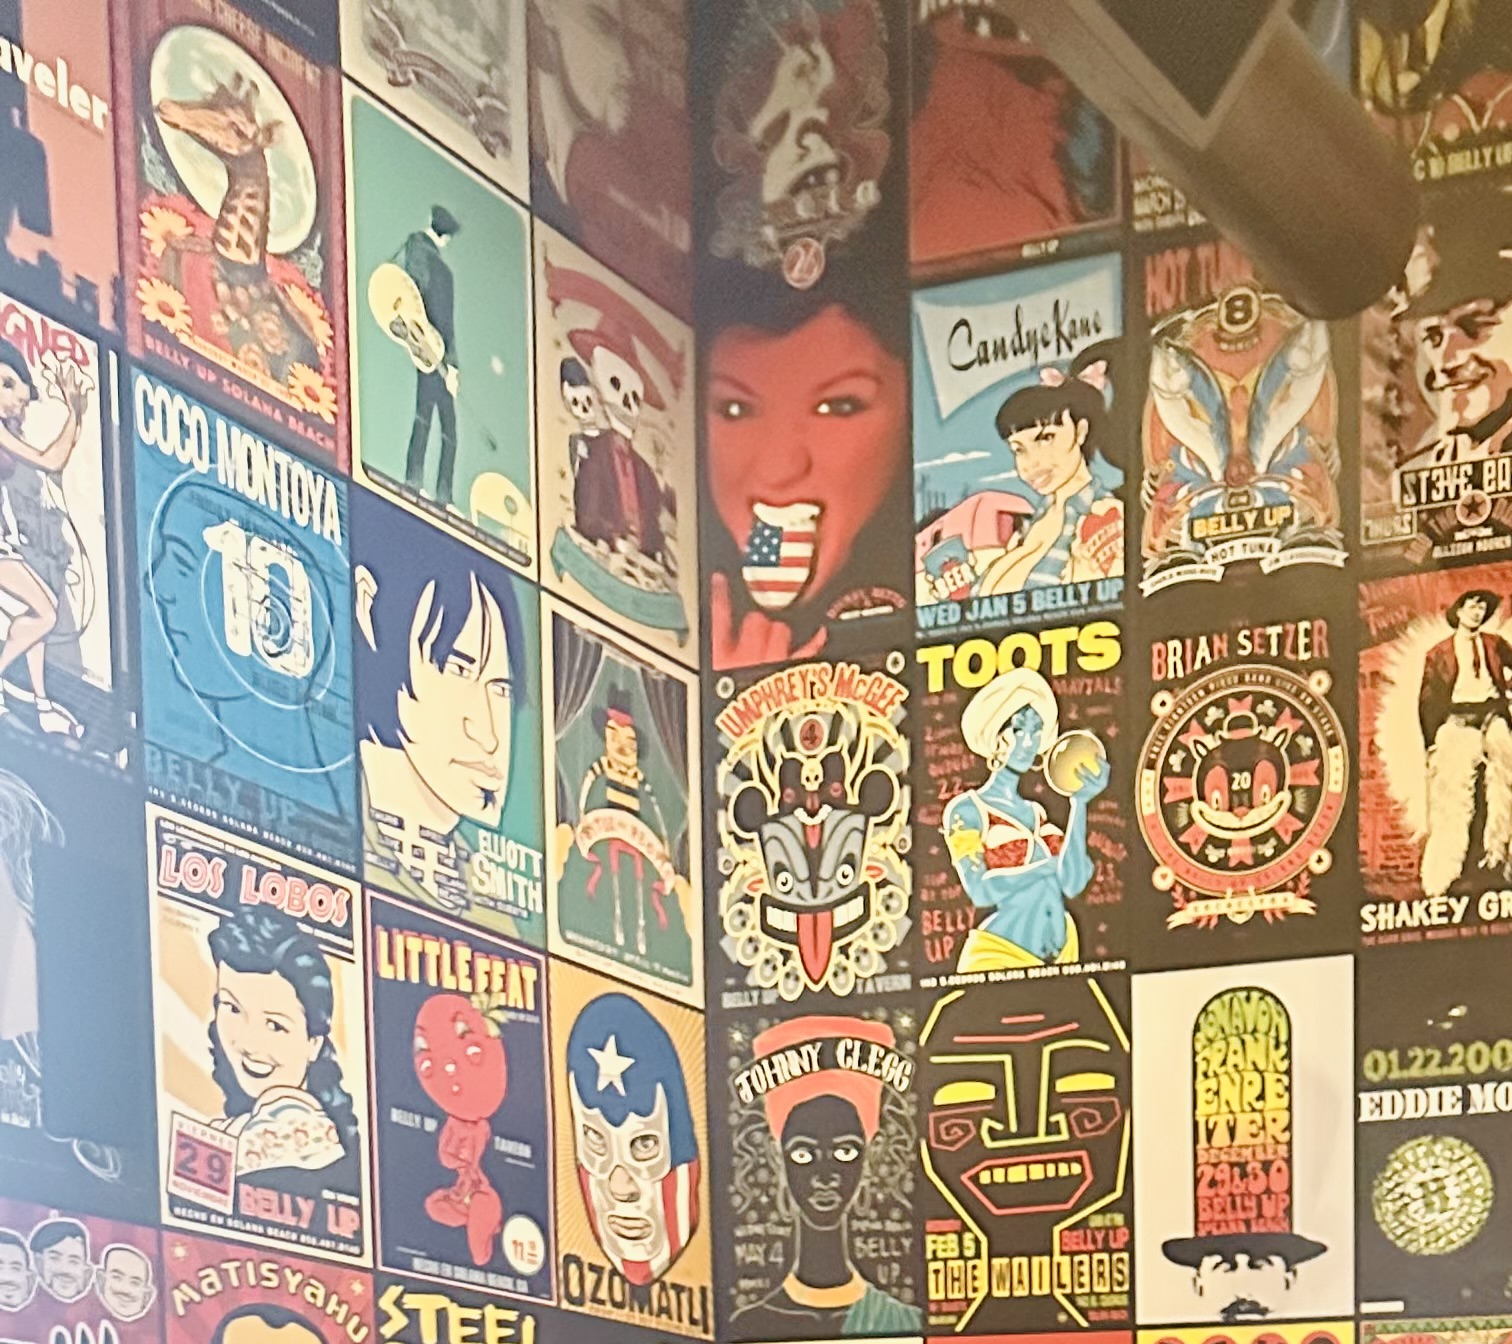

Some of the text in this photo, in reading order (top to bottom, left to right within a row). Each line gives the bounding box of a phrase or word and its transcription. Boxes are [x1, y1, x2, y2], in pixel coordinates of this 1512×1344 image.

[145, 335, 337, 450] BELLY UP SOLANA BEACH
[135, 374, 342, 546] COCO MONTOYA
[1191, 504, 1293, 540] BELLY UP
[916, 602, 962, 629] WED
[966, 596, 1011, 623] JAN
[1013, 594, 1025, 617] 5
[1031, 584, 1092, 615] BELLY
[1096, 577, 1125, 606] UP
[934, 563, 974, 600] BEER
[916, 620, 1122, 693] TOOTS
[1151, 618, 1330, 681] BRIAN SETZER
[715, 661, 834, 742] UMPHREY'S
[1230, 771, 1251, 790] 20
[158, 844, 350, 928] LOS LOBOS
[471, 829, 544, 914] ELLIOTT SMITH
[921, 906, 976, 936] BELLY
[1360, 892, 1470, 935] SHAKEY
[375, 924, 473, 992] LITTLE
[473, 951, 537, 1011] FEAT
[924, 935, 955, 963] UP
[721, 990, 760, 1009] BELLY
[855, 973, 912, 995] TAVERN
[734, 1036, 913, 1104] JOHNNY CLEGG
[1196, 1032, 1290, 1082] FRANK
[1195, 1070, 1291, 1115] ENRE
[1358, 1086, 1463, 1124] EDDIE
[1196, 1110, 1291, 1148] ITER
[175, 1140, 228, 1186] 29
[1197, 1145, 1289, 1164] DECEMBER
[239, 1183, 361, 1240] BELLY UP
[1198, 1194, 1290, 1222] BELLY UP
[853, 1236, 913, 1259] BELLY
[926, 1231, 960, 1260] FEB
[1060, 1226, 1130, 1252] BELLY UP
[562, 1252, 710, 1329] OZOMATLI
[927, 1251, 1130, 1300] THE WAILERS
